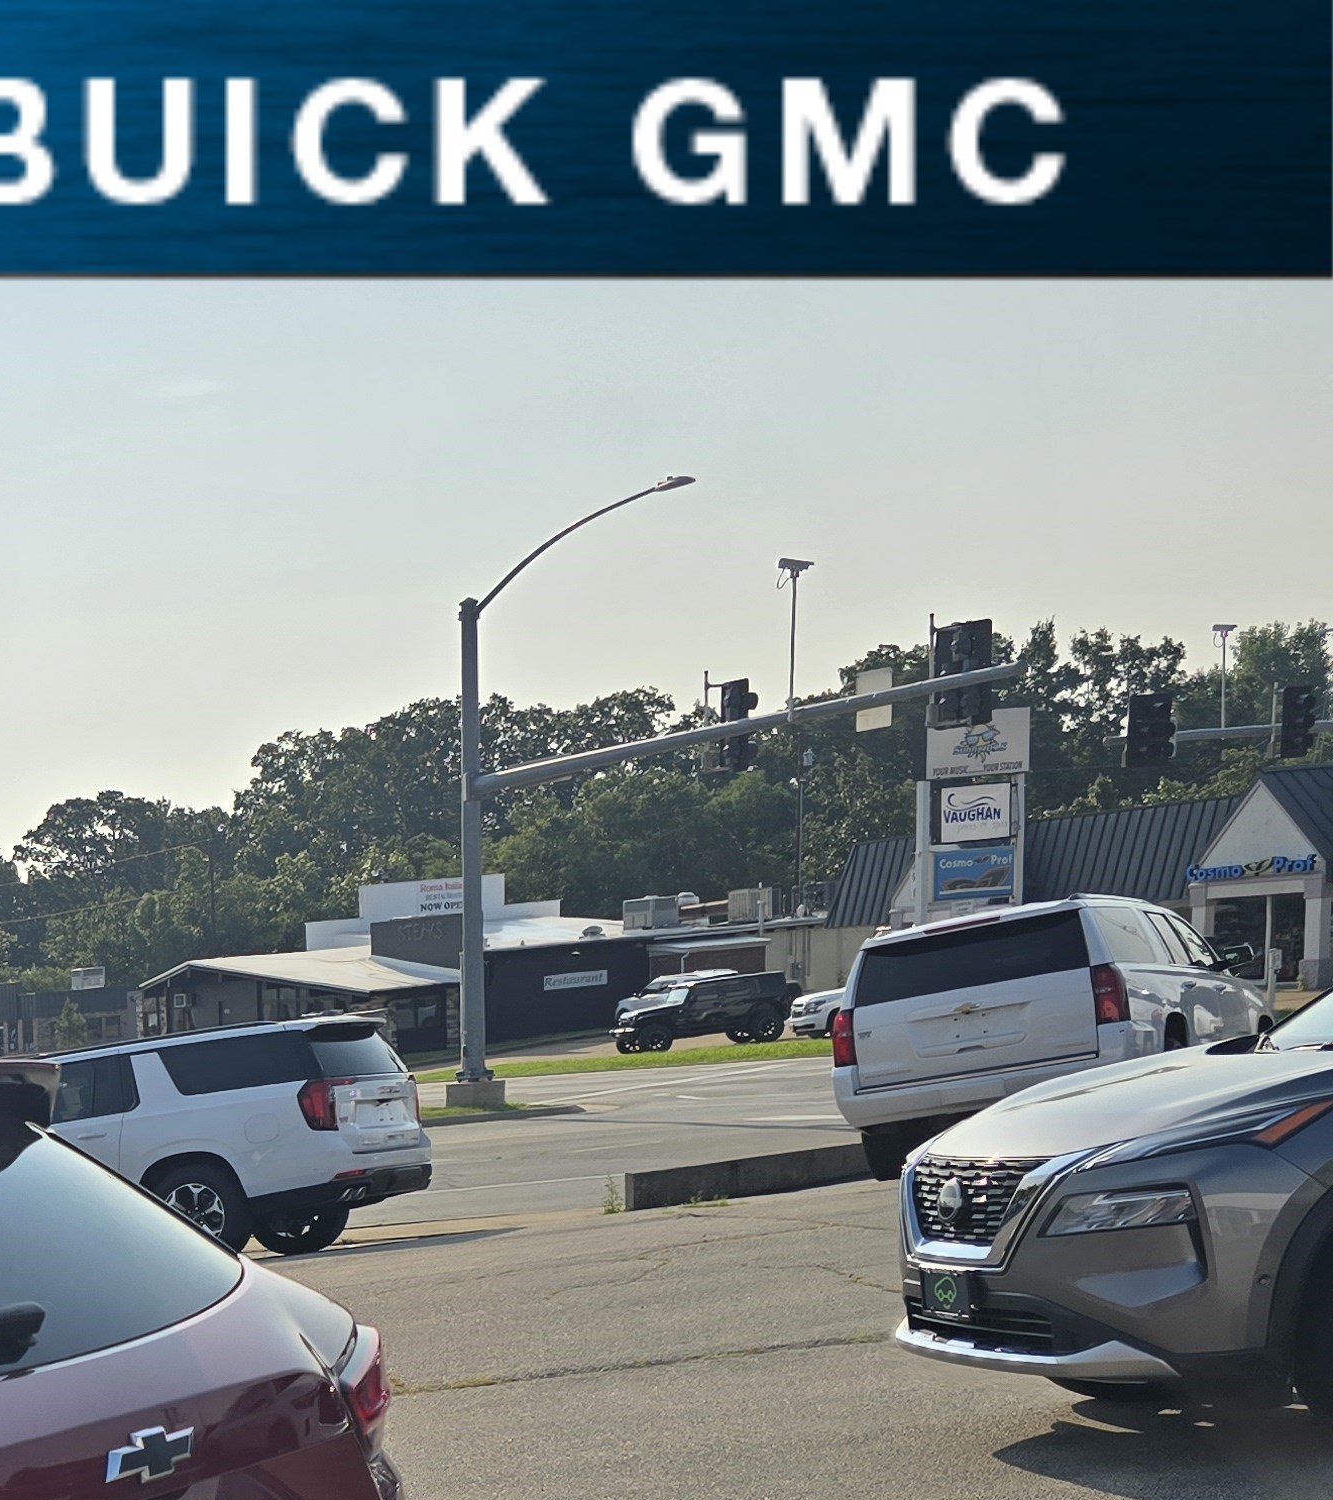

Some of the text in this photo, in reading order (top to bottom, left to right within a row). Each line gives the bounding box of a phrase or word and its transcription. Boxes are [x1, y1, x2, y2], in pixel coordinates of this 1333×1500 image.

[943, 806, 1001, 823] VAUGHAN
[940, 858, 973, 869] Cosmo
[1186, 854, 1316, 881] Cosmo Prof
[420, 901, 462, 911] NOW OPE
[544, 973, 604, 989] Restaurant
